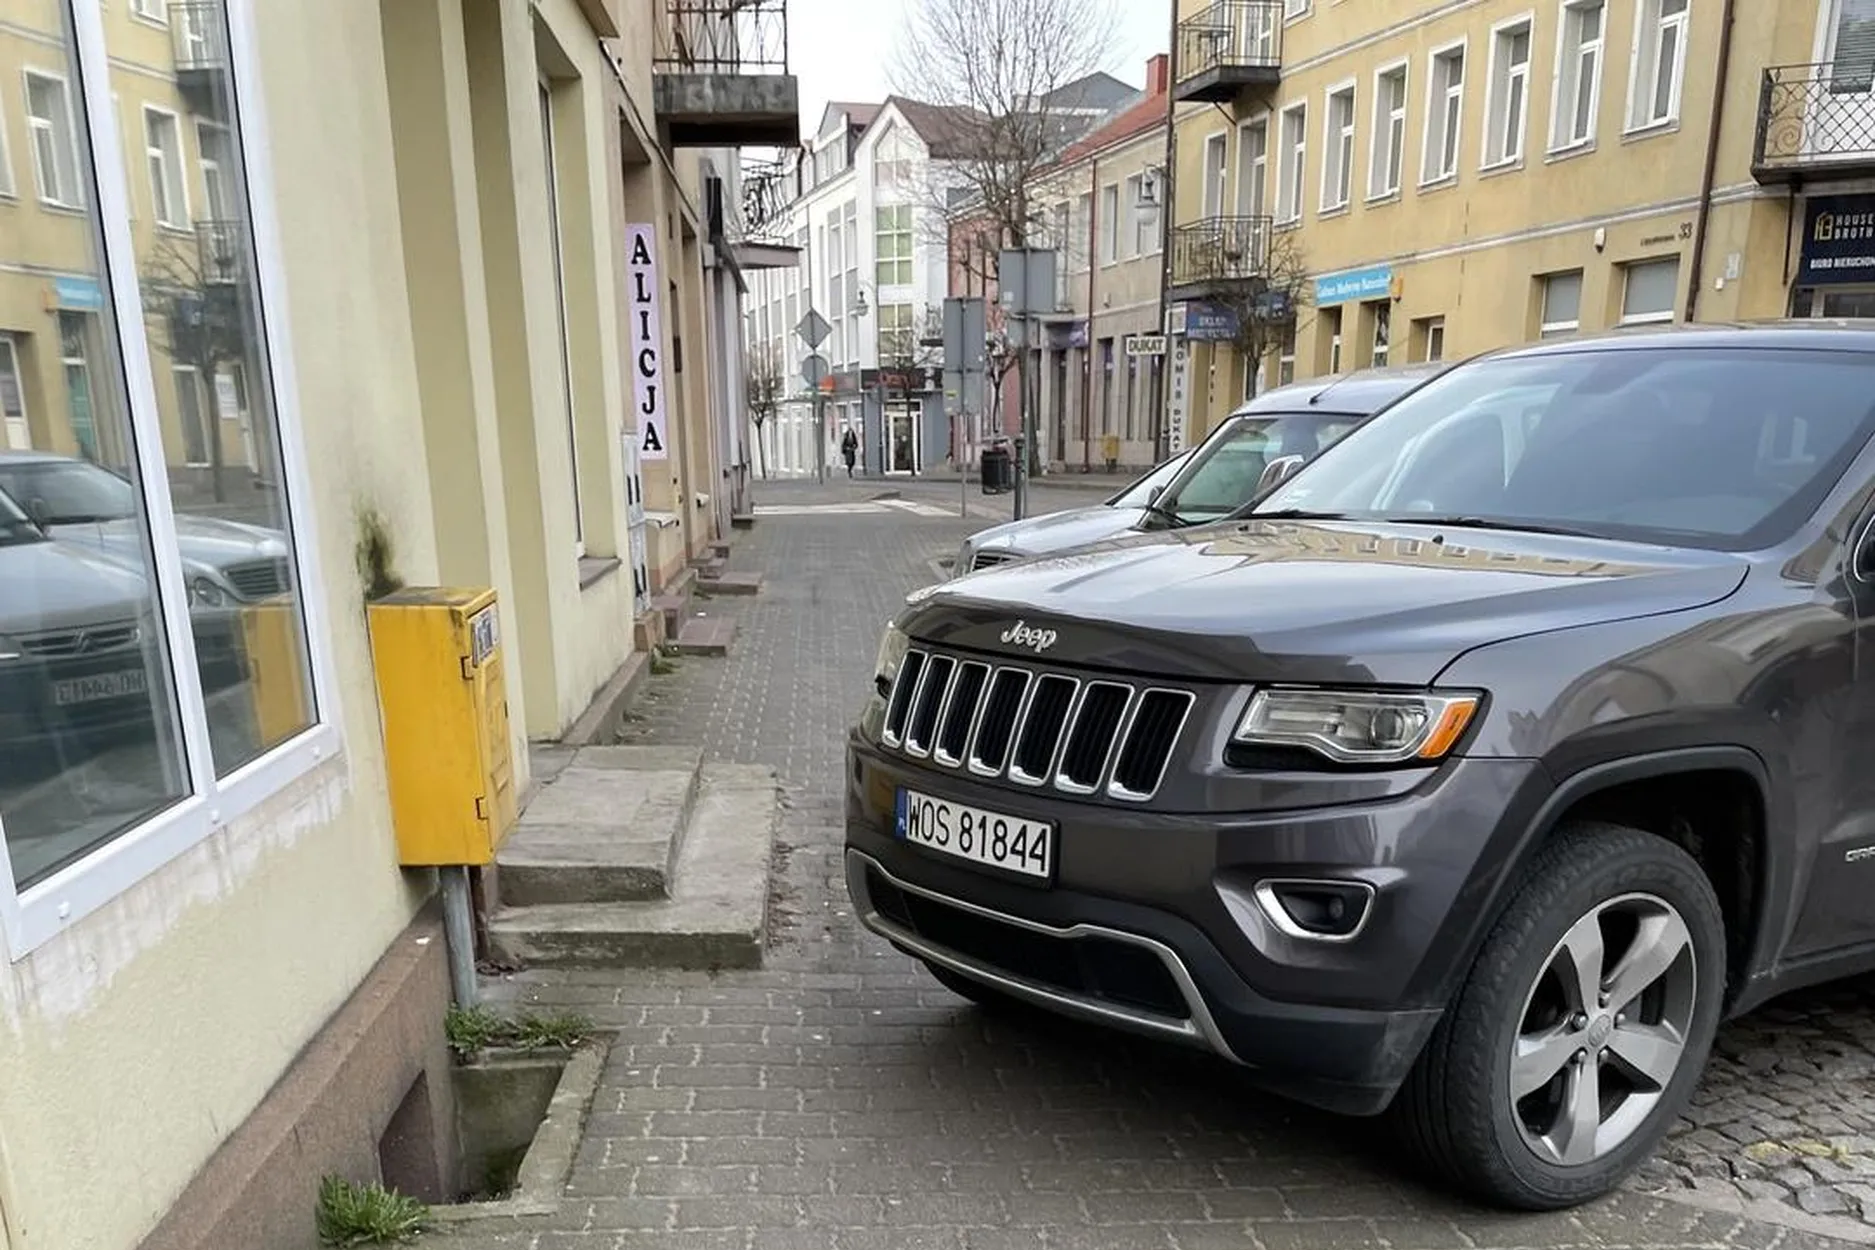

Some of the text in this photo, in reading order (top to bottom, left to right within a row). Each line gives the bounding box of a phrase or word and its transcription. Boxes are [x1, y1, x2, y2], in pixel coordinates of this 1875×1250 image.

[1679, 221, 1692, 240] 33
[1836, 213, 1874, 226] HOUSE
[631, 233, 662, 451] ALICJA
[1129, 339, 1163, 352] DUKAT
[1001, 619, 1057, 653] Jeep
[907, 796, 1048, 872] WOS 81844
